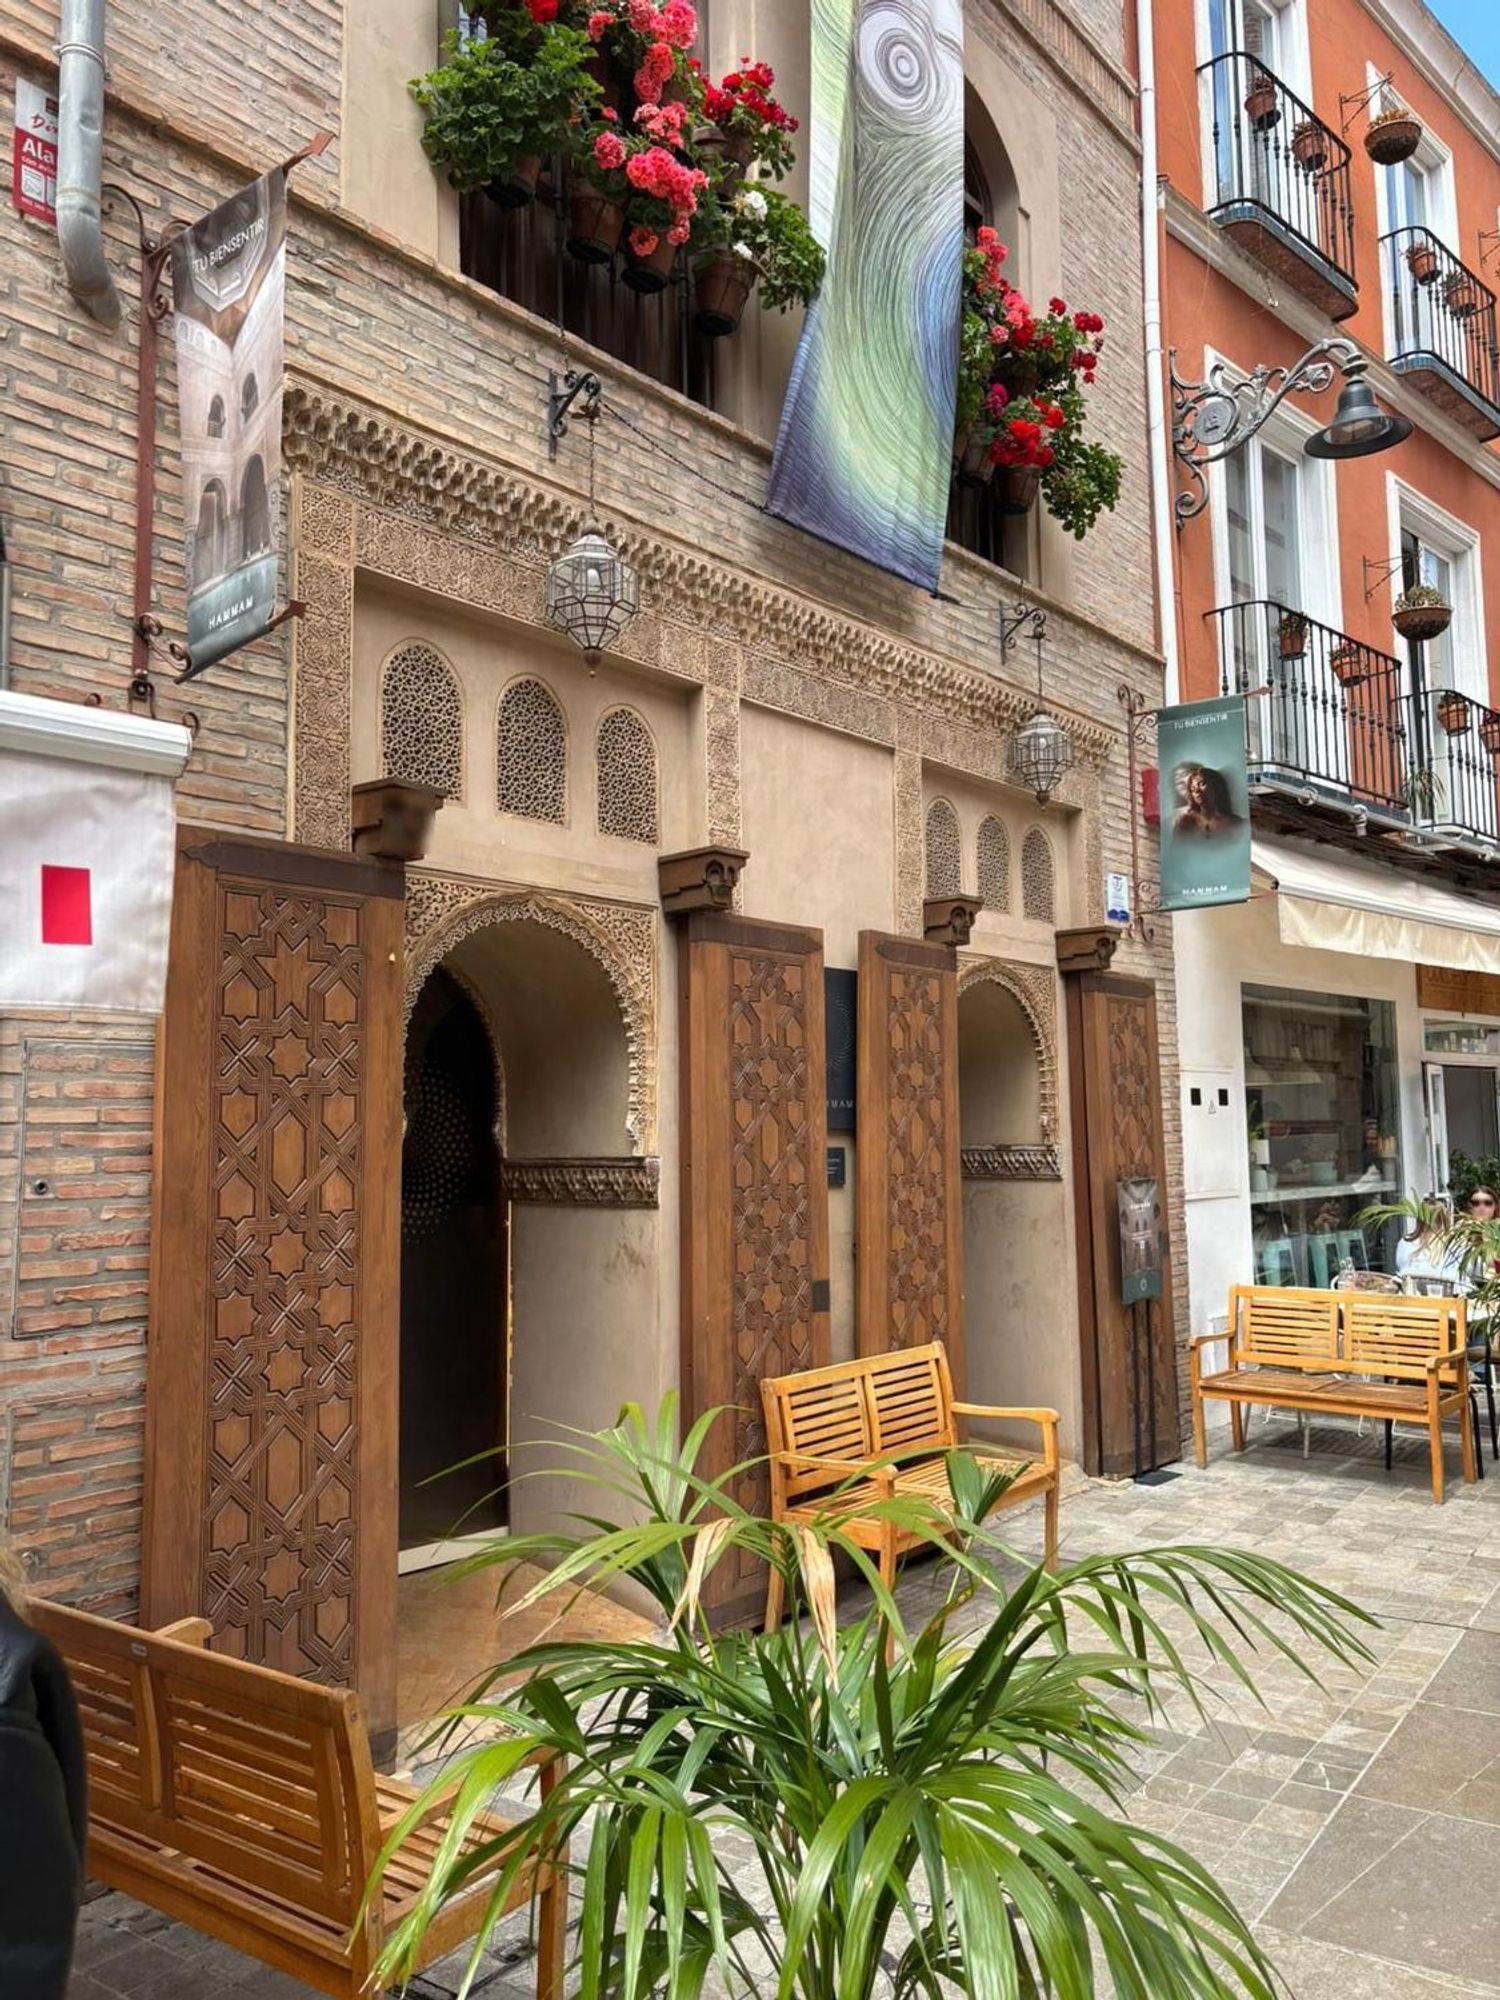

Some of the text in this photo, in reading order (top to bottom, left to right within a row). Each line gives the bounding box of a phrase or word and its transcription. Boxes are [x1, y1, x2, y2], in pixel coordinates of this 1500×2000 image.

[193, 218, 264, 273] TU BIENSENTIR
[208, 595, 254, 631] HAMMAM
[1182, 885, 1228, 897] HAMMAM
